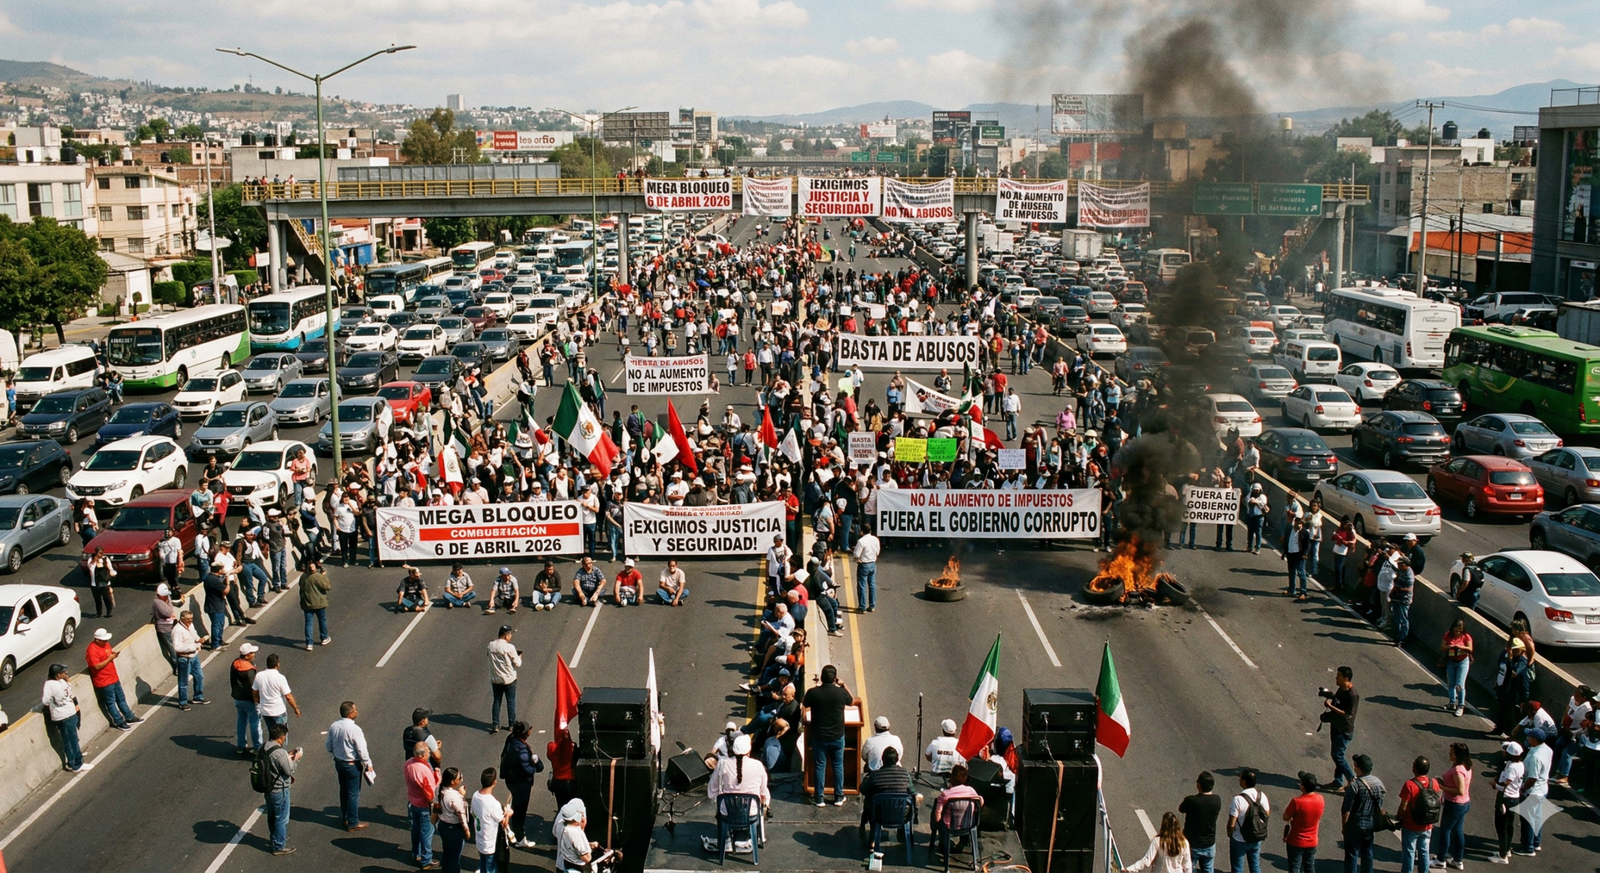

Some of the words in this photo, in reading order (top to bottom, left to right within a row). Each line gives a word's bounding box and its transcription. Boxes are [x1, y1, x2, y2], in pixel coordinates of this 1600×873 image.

[647, 182, 677, 194] MEGA
[680, 181, 730, 195] BLOQUEO
[810, 179, 868, 190] ¡EXIGIMOS
[647, 196, 654, 207] 6
[656, 196, 669, 207] DE
[671, 196, 701, 207] ABRIL
[704, 195, 730, 207] 2026
[809, 191, 860, 202] JUSTICIA
[862, 191, 869, 202] Y
[1000, 191, 1011, 199] NO
[1024, 192, 1064, 202] AUMENTO
[805, 203, 874, 214] SEGURIDAD!
[1009, 201, 1018, 209] DE
[885, 206, 897, 217] NO
[899, 207, 914, 218] TAL
[916, 206, 953, 218] ABUSOS
[1003, 209, 1013, 218] DE
[1016, 210, 1058, 220] IMPUESOS
[1112, 208, 1148, 218] GOBIERNO
[841, 339, 888, 360] BASTA
[893, 341, 911, 361] DE
[916, 341, 976, 362] ABUSOS
[628, 369, 641, 379] NO
[645, 369, 656, 379] AL
[660, 368, 706, 379] AUMENTO
[633, 382, 645, 392] DE
[648, 381, 703, 392] IMPUESTOS
[910, 493, 925, 506] NO
[928, 493, 941, 506] AL
[944, 494, 995, 507] AUMENTO
[998, 494, 1011, 507] DE
[1014, 494, 1073, 507] IMPUESTOS
[1190, 490, 1222, 499] FUERA
[1225, 492, 1236, 500] EL
[1187, 501, 1237, 511] GOBIERNO
[419, 509, 476, 525] MEGA
[482, 504, 578, 522] BLOQUEO
[1182, 511, 1235, 521] CORRUPTO
[880, 511, 925, 531] FUERA
[929, 512, 945, 532] EL
[950, 511, 1020, 532] GOBIERNO
[1024, 511, 1097, 532] CORRUPTO
[629, 520, 707, 537] ¡EXIGIMOS
[712, 518, 782, 534] JUSTICIA
[434, 543, 444, 556] 6
[449, 542, 469, 555] DE
[474, 541, 520, 554] ABRIL
[525, 539, 562, 552] 2026
[652, 538, 662, 551] Y
[667, 537, 758, 551] SEGURIDAD!
